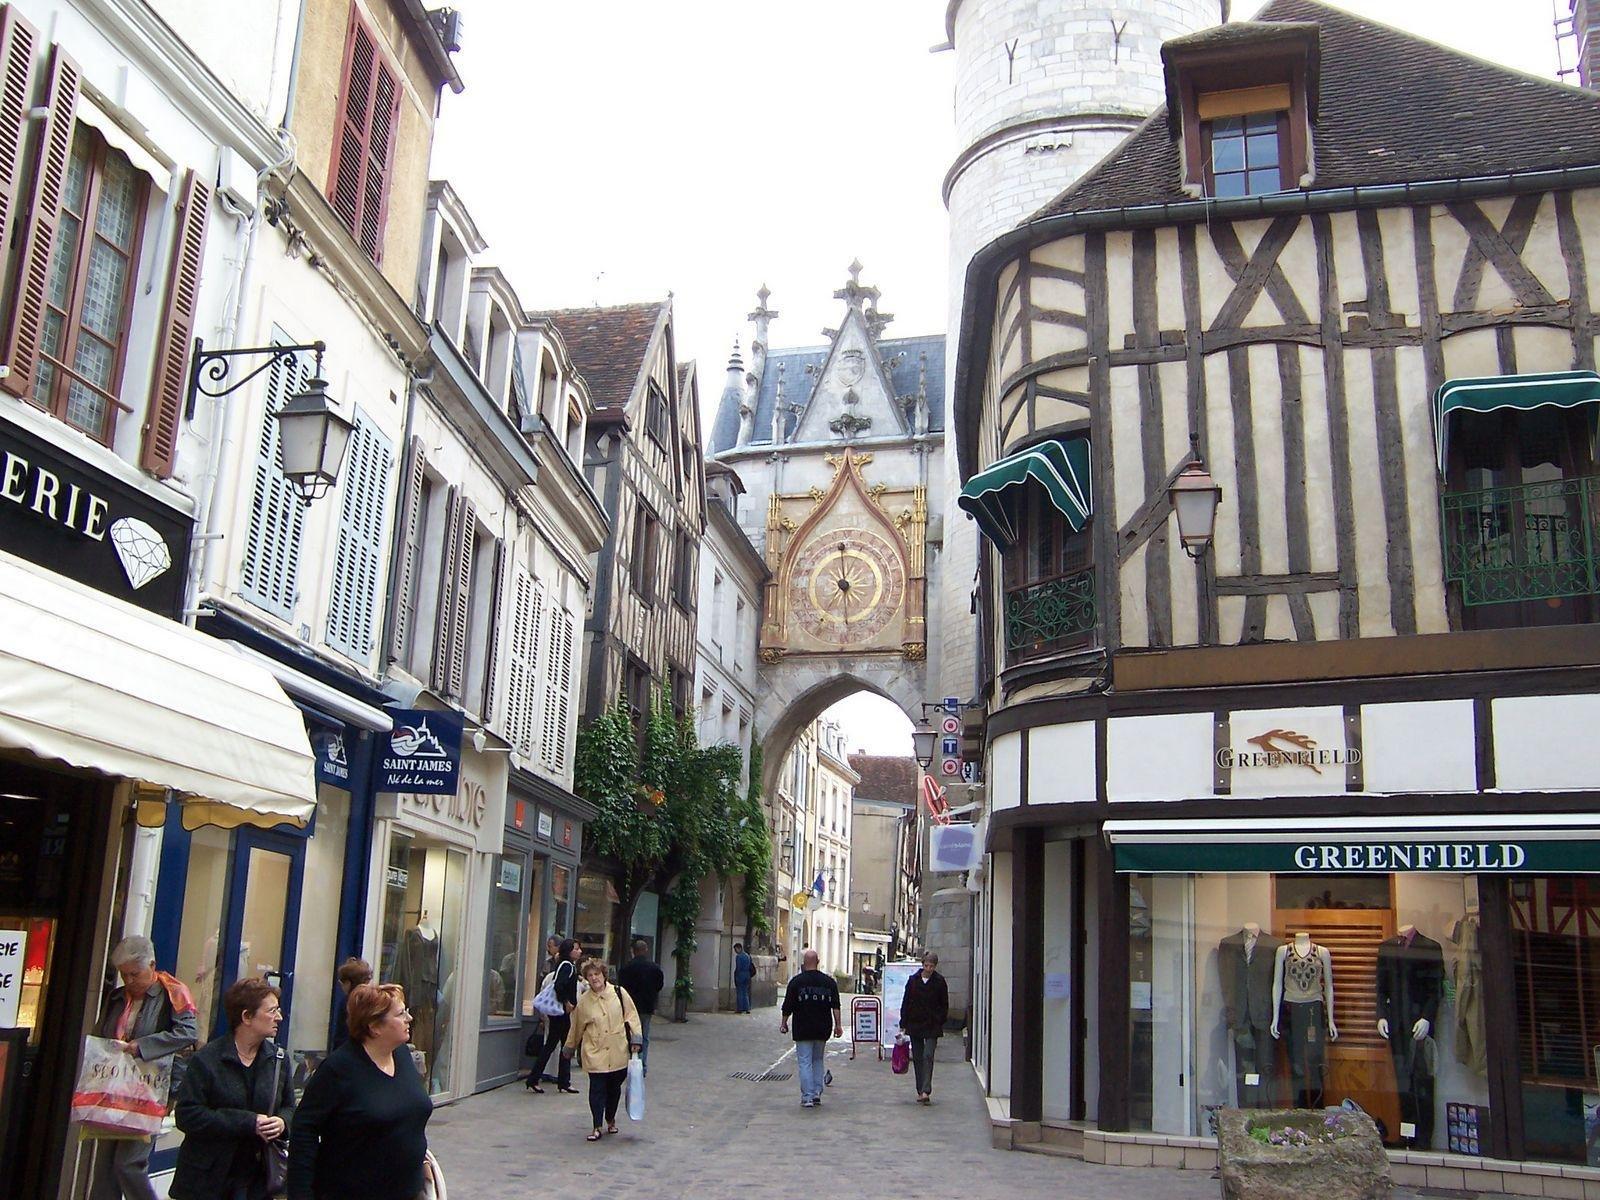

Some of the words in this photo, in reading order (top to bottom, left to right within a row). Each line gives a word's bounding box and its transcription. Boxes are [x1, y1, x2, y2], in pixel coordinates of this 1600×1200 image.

[0, 450, 108, 542] ERIE
[383, 758, 417, 770] SAINT
[417, 760, 452, 772] JAMES
[1216, 746, 1362, 769] GREENFIELD
[323, 761, 336, 775] SAINT
[336, 766, 348, 779] JAMES
[387, 774, 401, 785] Né
[402, 774, 413, 785] de
[413, 774, 424, 785] la
[426, 778, 444, 786] mer
[1294, 844, 1525, 869] GREENFIELD
